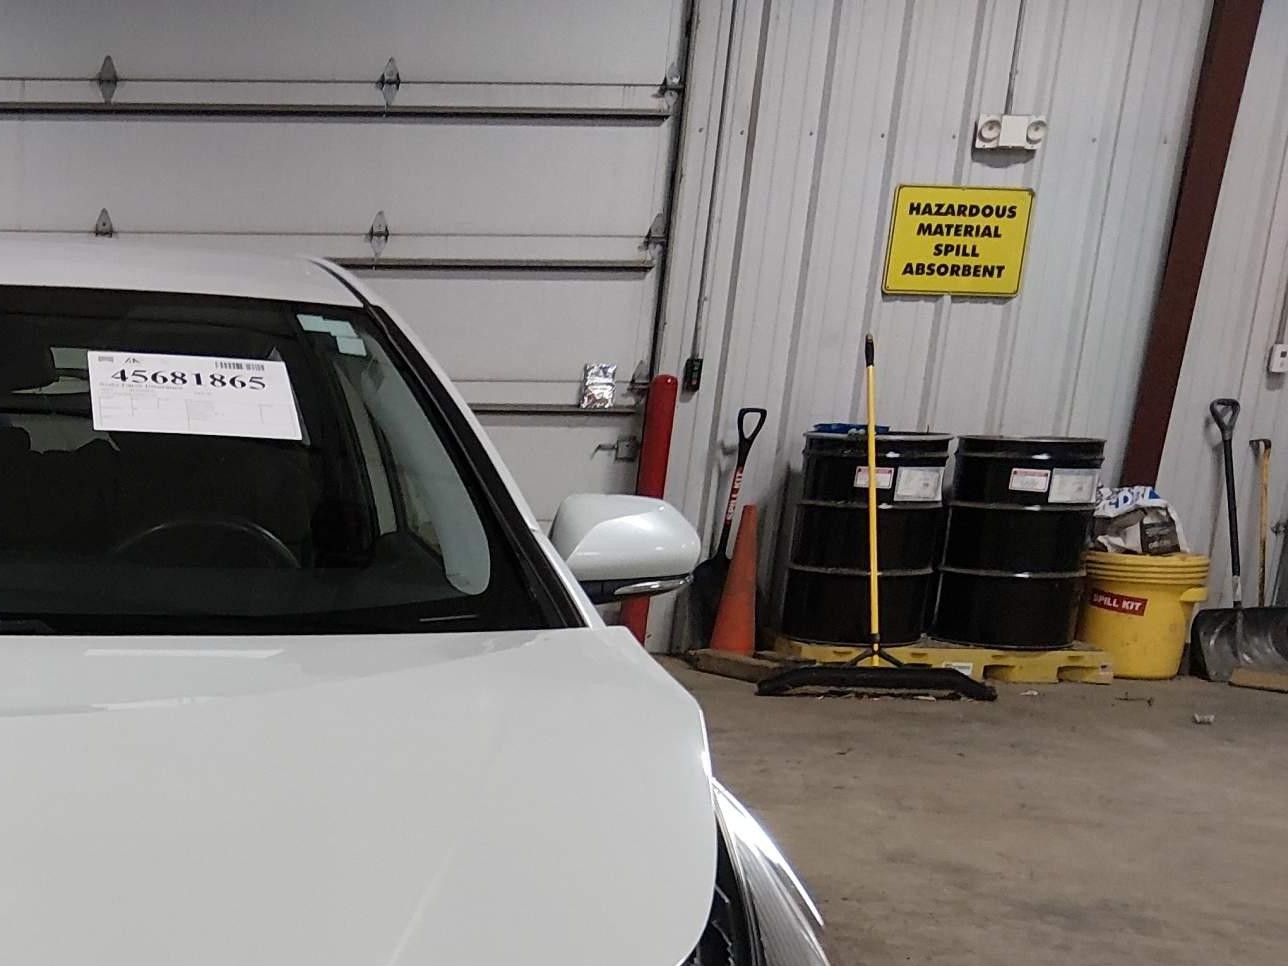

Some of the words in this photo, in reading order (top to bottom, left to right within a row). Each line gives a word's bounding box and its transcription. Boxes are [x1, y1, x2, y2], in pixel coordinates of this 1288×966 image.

[909, 202, 1017, 219] HAZARDOUS
[916, 222, 1002, 238] MATERIAL
[933, 243, 980, 258] SPILL
[901, 262, 1006, 278] ABSORBENT
[111, 368, 267, 390] 45681865
[1093, 593, 1119, 608] SPILL
[1121, 599, 1143, 611] KIT
